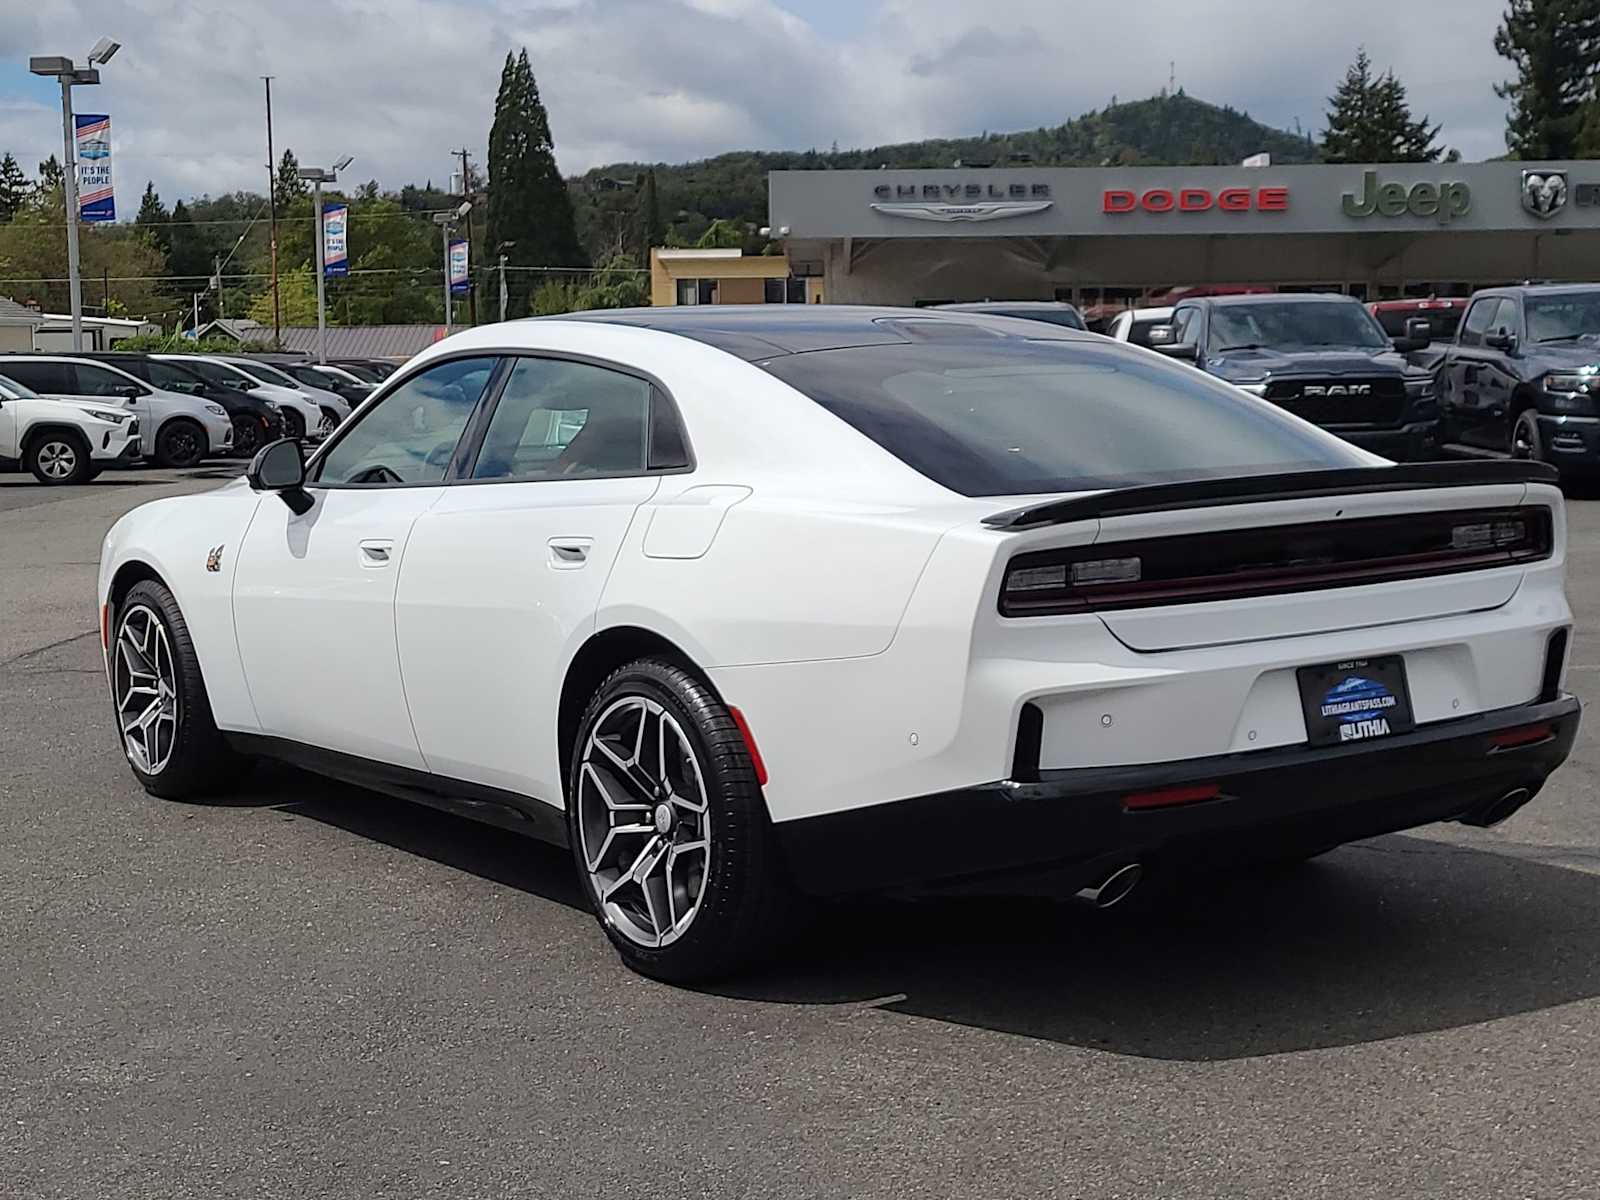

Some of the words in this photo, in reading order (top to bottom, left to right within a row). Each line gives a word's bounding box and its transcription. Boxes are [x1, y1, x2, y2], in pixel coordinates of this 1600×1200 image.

[81, 165, 95, 175] IT'S
[96, 165, 110, 175] THE
[83, 175, 110, 185] PEOPLE
[874, 184, 1049, 199] CHRYSLER
[1103, 187, 1289, 213] DODGE
[1342, 170, 1471, 225] Jeep
[1303, 384, 1371, 397] RAM
[1321, 696, 1397, 716] LITHIAGRANTSPASS.COM
[1351, 718, 1391, 739] LITHIA
